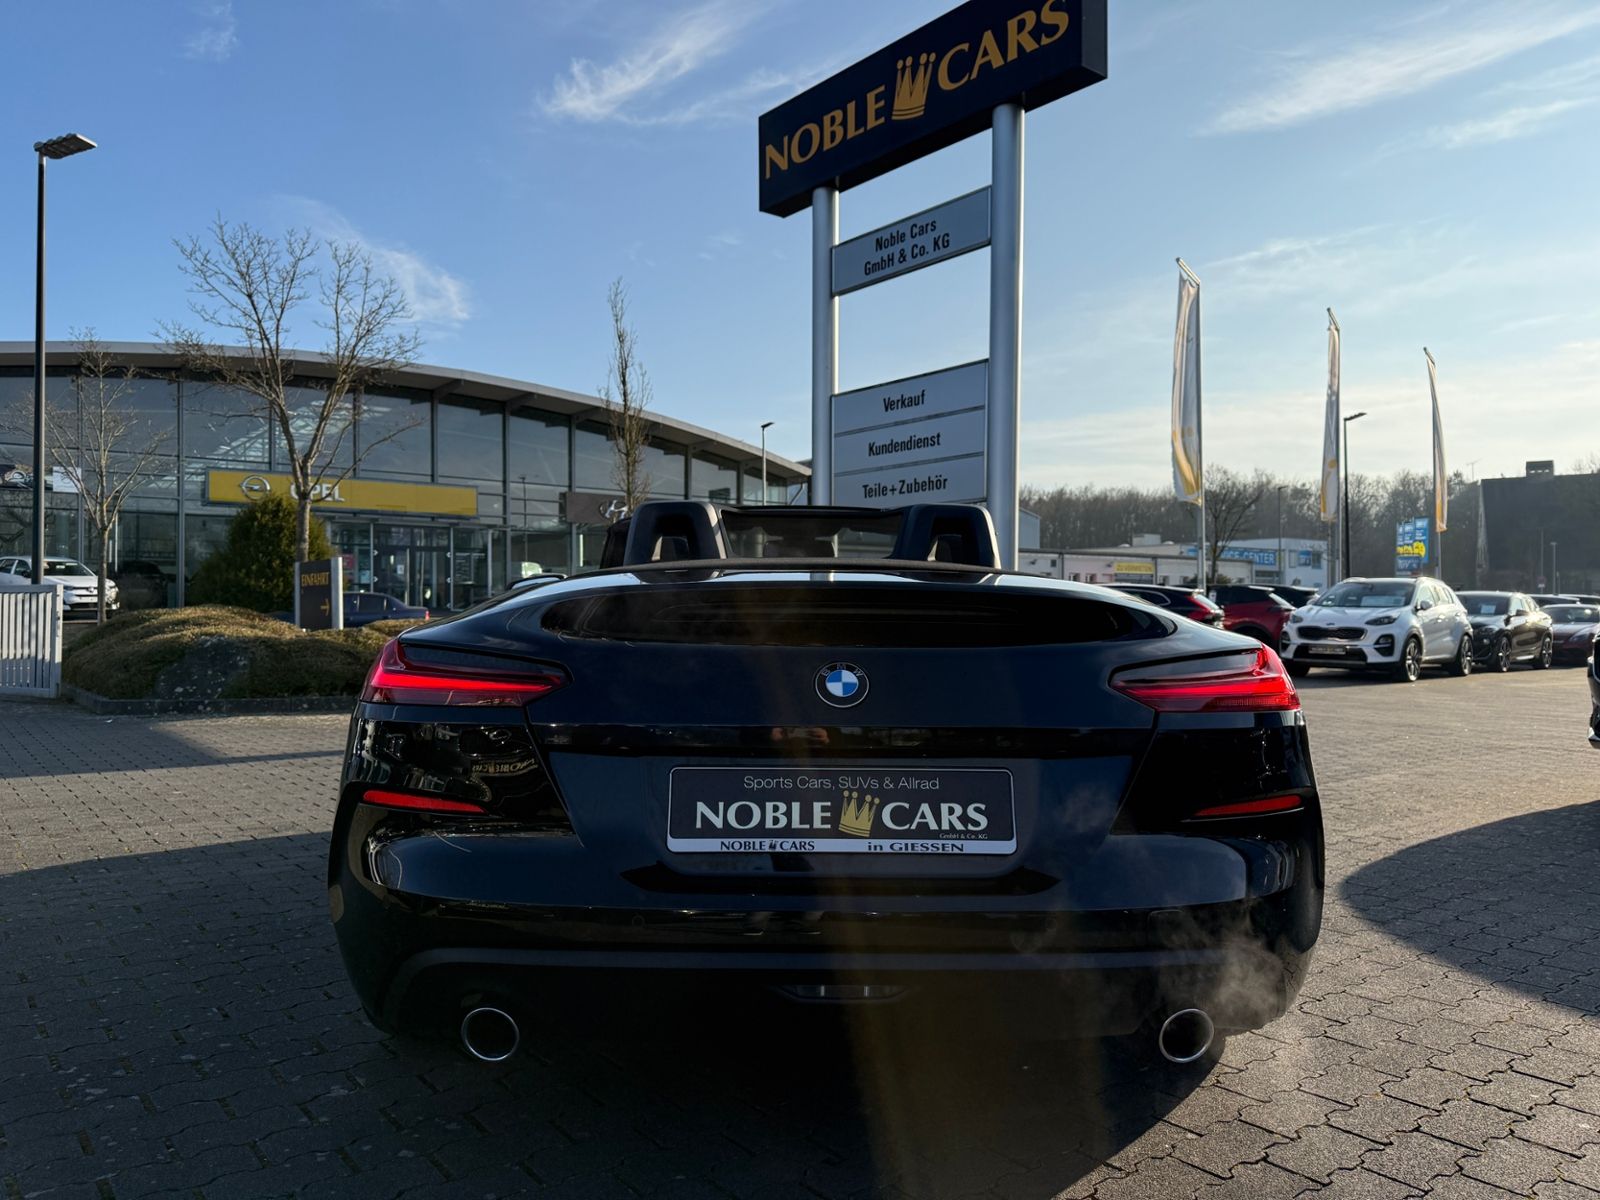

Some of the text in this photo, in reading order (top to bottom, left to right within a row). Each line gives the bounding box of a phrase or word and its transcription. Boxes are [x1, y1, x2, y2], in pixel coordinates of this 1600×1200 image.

[764, 0, 1069, 180] NOBLE CARS
[875, 219, 937, 252] Noble Cars
[864, 234, 950, 276] GmbH & Co. KG
[883, 389, 926, 412] Verkauf
[868, 432, 941, 457] Kundendienst
[862, 474, 948, 499] Teile+Zubehör
[301, 572, 330, 587] EINFAHRT
[820, 663, 864, 677] BMW
[743, 776, 940, 792] Sports Cars, SUVs & Allrad
[695, 801, 988, 831] NOBLE CARS
[720, 840, 965, 852] NOBLE CARS in GIESSEN
